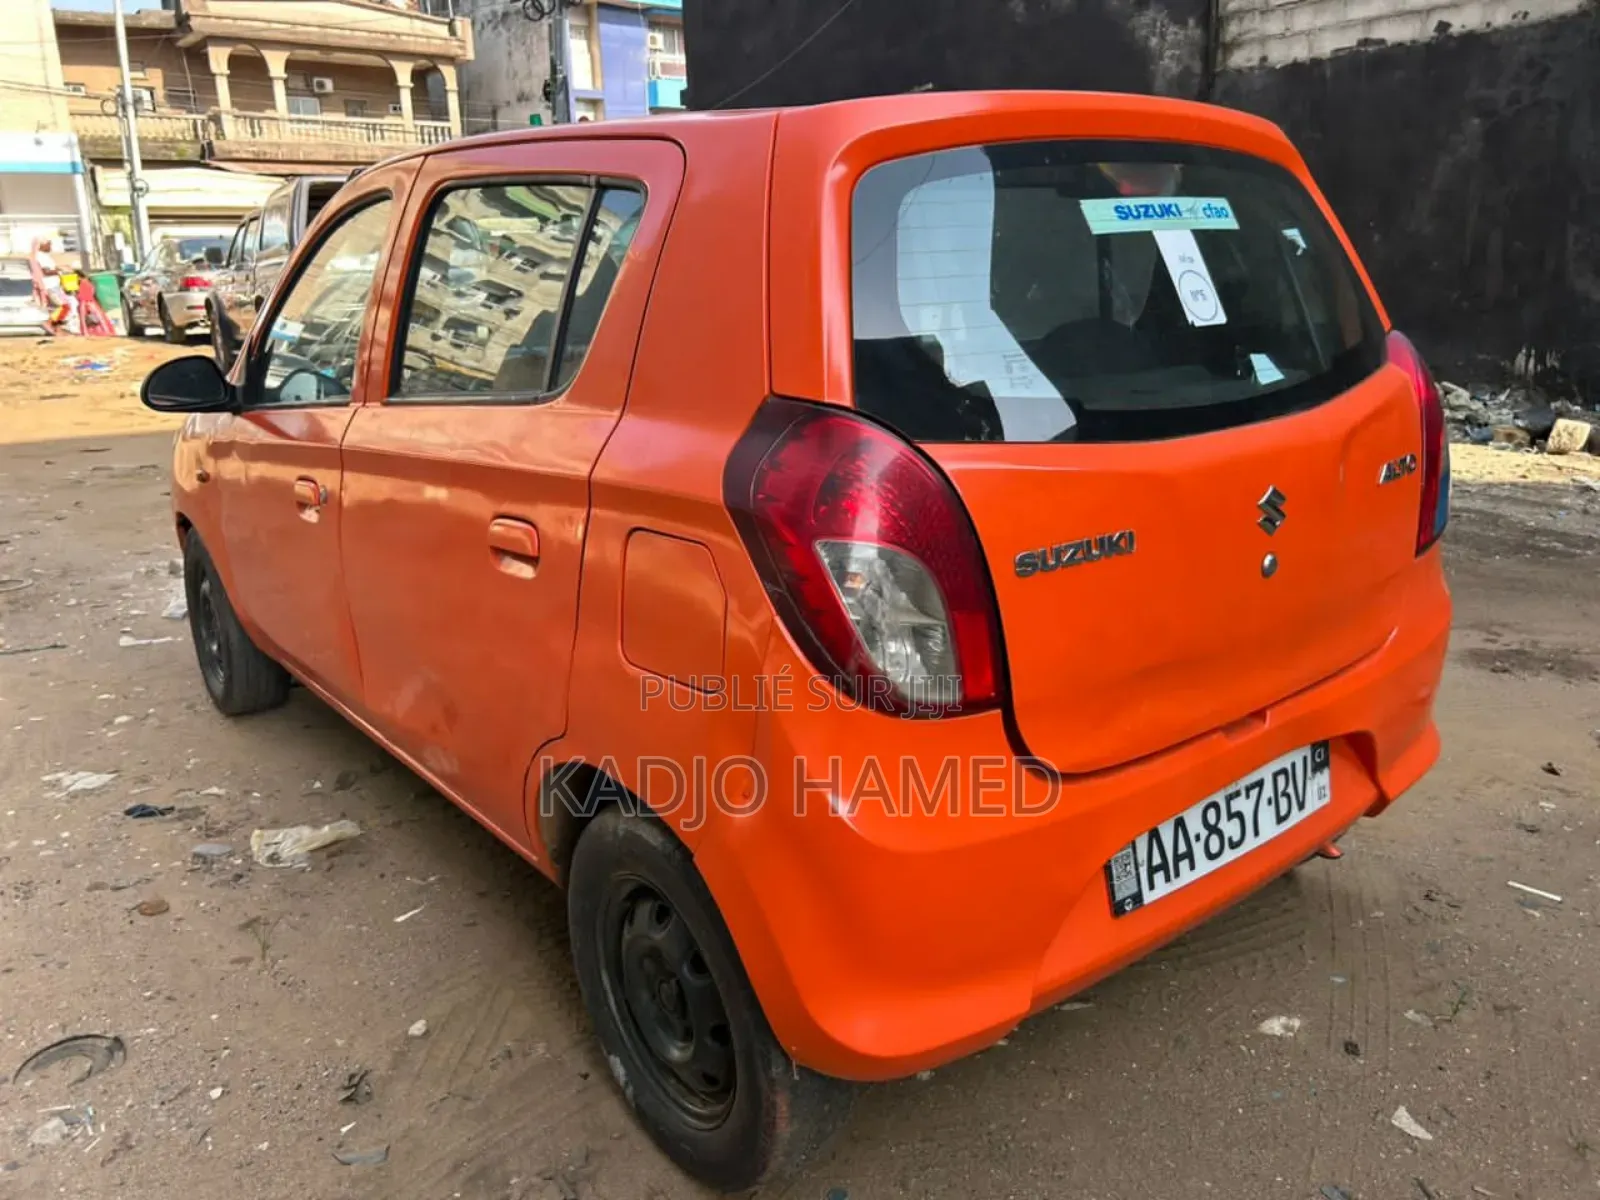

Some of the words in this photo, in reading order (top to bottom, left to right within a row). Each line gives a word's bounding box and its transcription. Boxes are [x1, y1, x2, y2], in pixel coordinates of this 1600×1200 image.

[1113, 202, 1183, 221] SUZUKI
[1202, 203, 1229, 219] cfao
[1379, 454, 1417, 484] ALTO
[1013, 529, 1136, 578] SUZUKI
